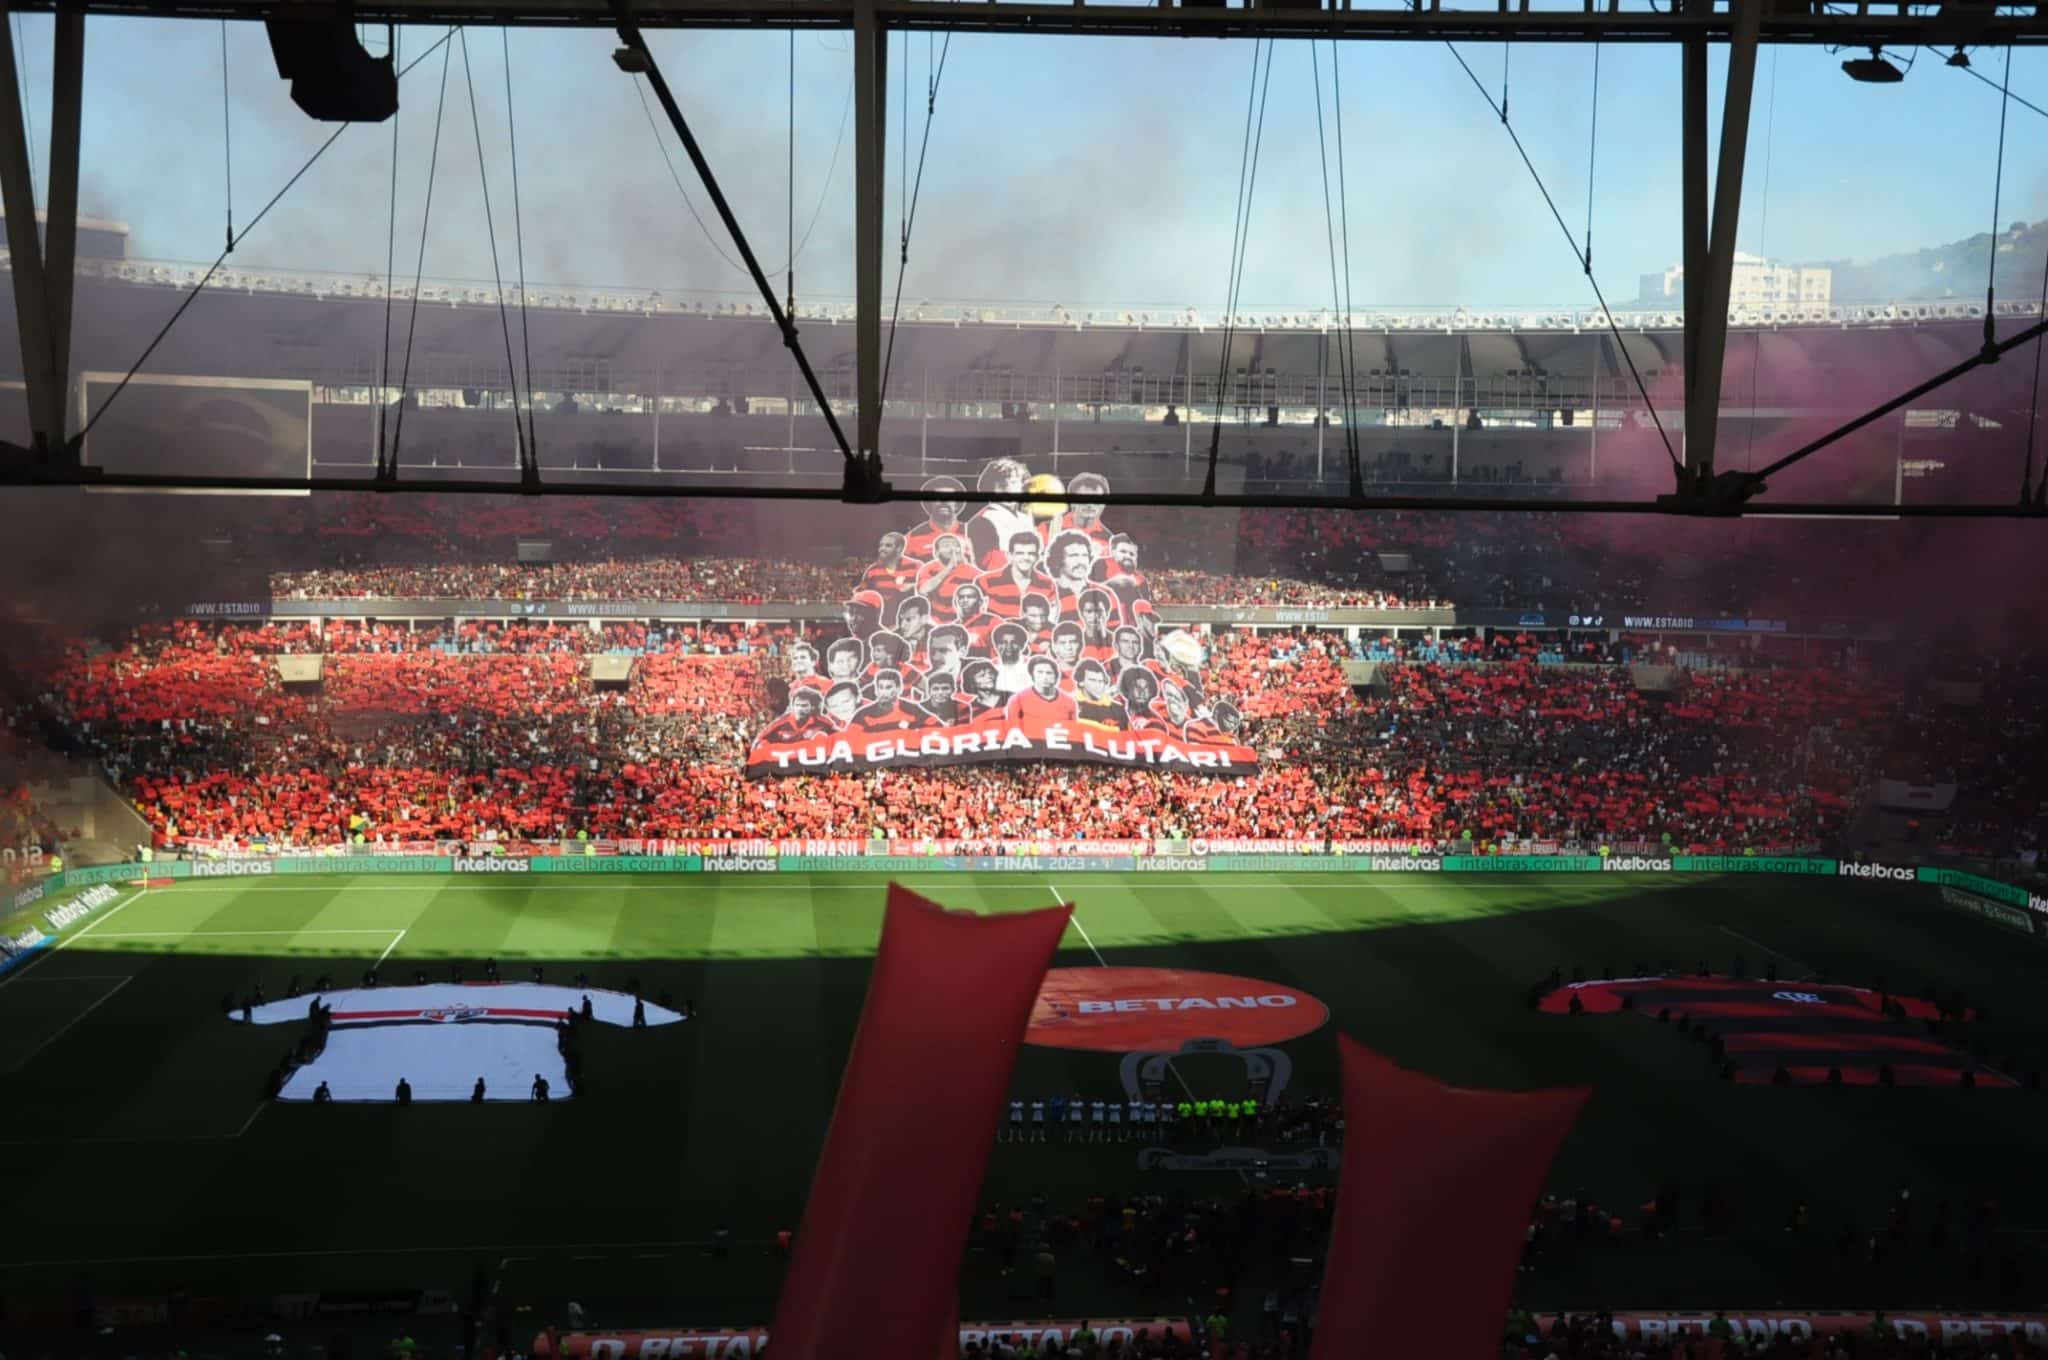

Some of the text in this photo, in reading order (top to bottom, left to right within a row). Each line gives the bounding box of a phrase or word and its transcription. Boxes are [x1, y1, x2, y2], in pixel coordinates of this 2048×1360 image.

[771, 723, 1232, 768] TUA GLÓRIA É LUTAR!
[663, 839, 701, 856] MIS
[806, 839, 858, 856] BRASIL
[192, 859, 272, 875] intelbras
[453, 857, 529, 872] intelbras
[703, 856, 777, 872] intelbras
[994, 857, 1085, 871] FINAL 2023
[1135, 856, 1207, 871] intelbras
[1371, 857, 1440, 872] intelbras
[1602, 856, 1671, 871] intelbras
[1839, 860, 1915, 881] intelbras
[1078, 994, 1297, 1014] BETANO
